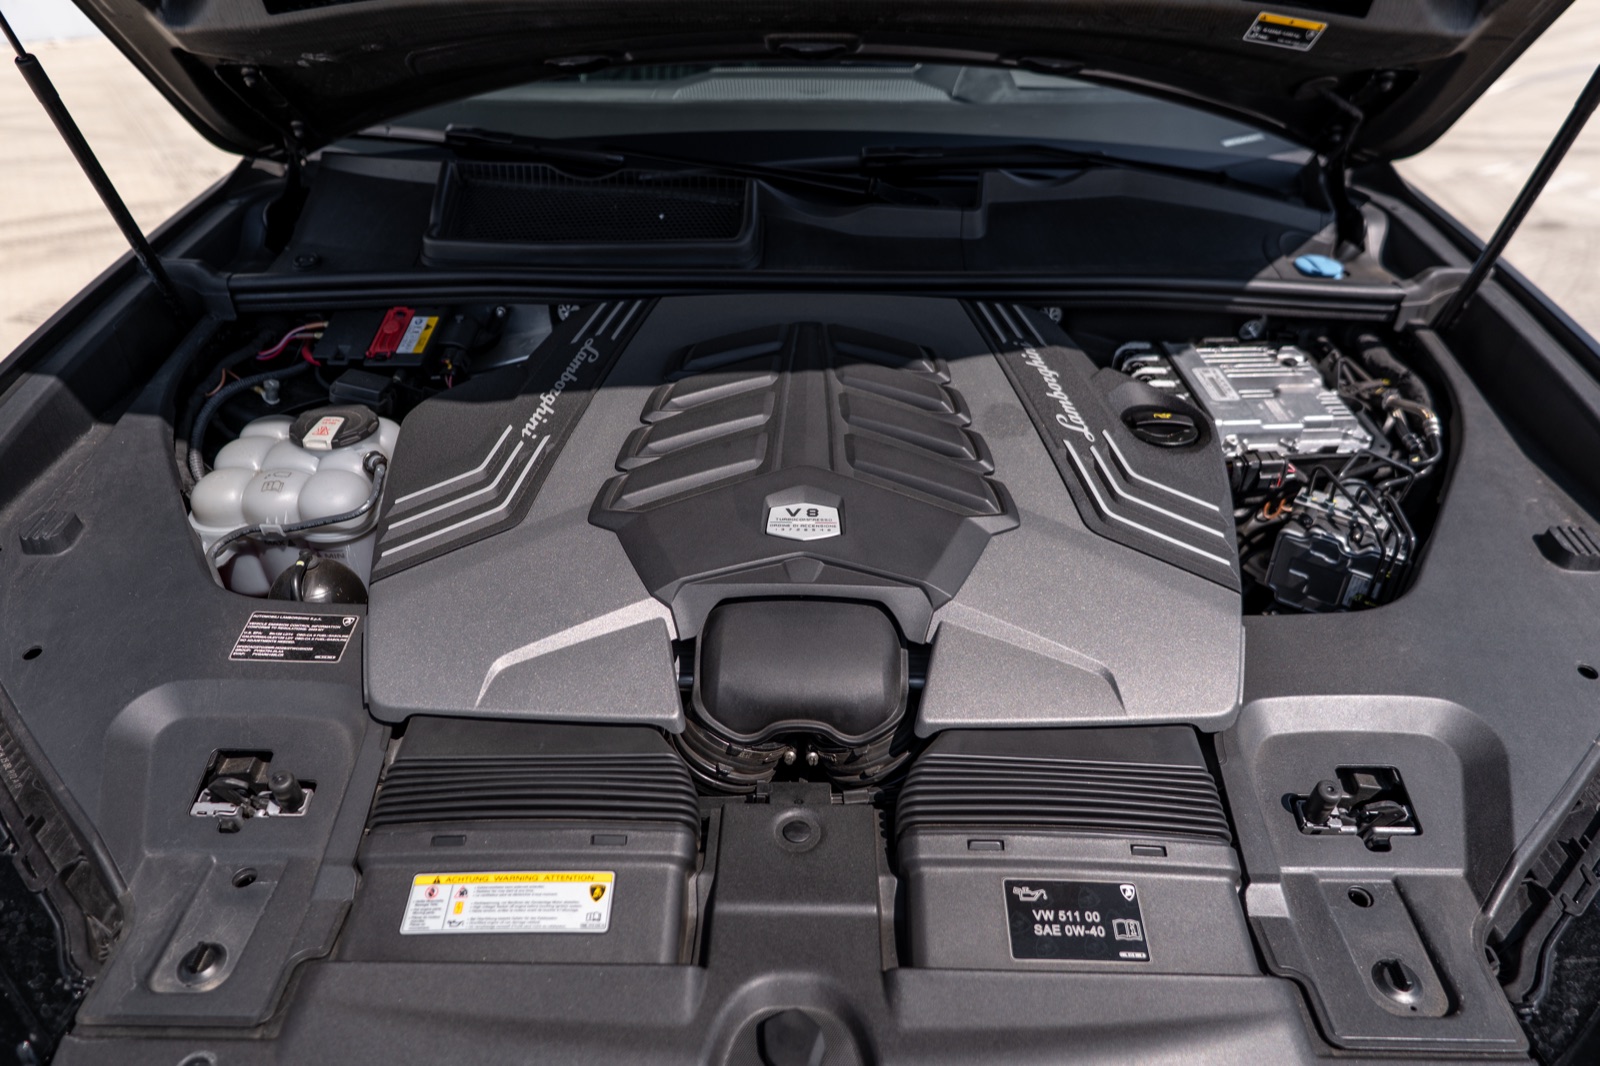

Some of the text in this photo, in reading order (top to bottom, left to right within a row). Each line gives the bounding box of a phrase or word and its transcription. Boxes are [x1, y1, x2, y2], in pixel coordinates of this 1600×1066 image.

[521, 337, 600, 440] Lamborghini
[1012, 340, 1096, 443] Lamborghini
[785, 507, 819, 518] V8
[445, 873, 596, 884] ACHTUNG WARNING ATTENTION
[1032, 909, 1101, 922] VW 511 00
[1033, 923, 1106, 938] SAE 0W-40
